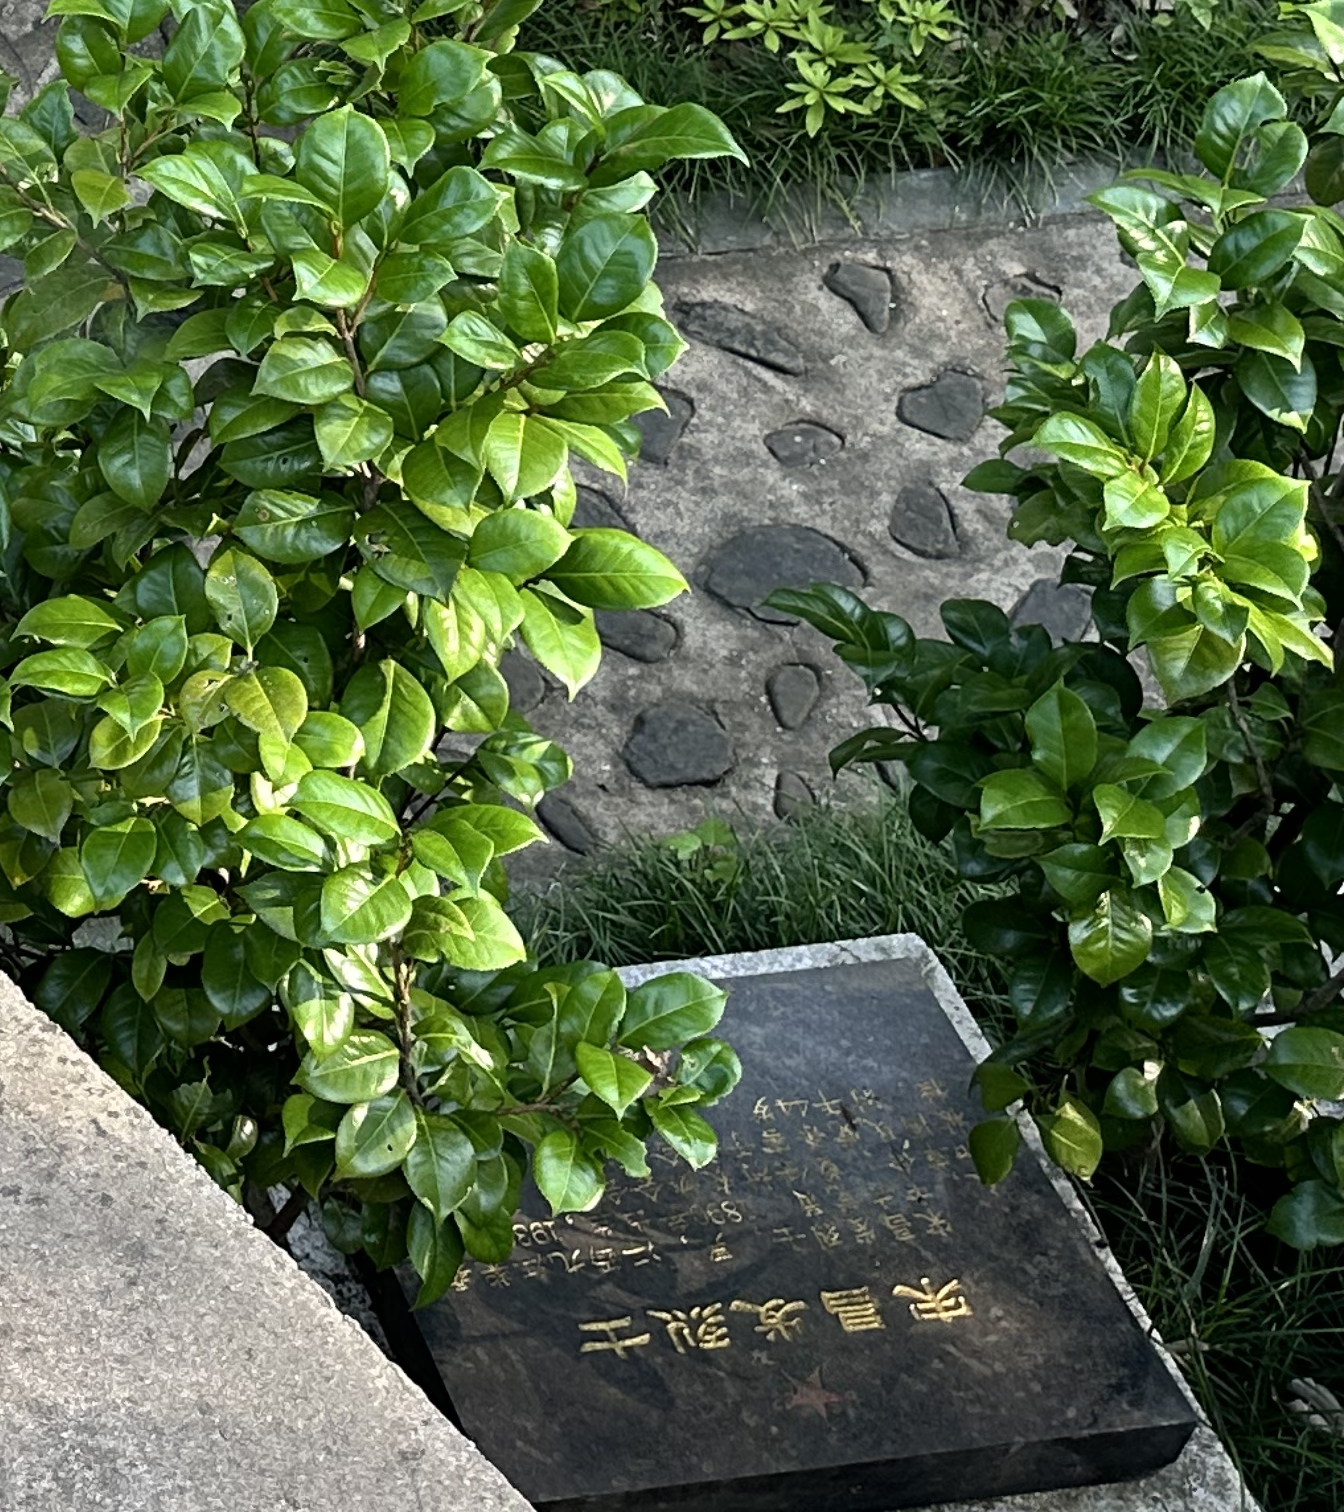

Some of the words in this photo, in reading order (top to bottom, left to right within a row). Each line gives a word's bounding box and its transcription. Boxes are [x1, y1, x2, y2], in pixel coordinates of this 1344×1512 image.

[577, 1276, 973, 1360] 宋昌发烈士
